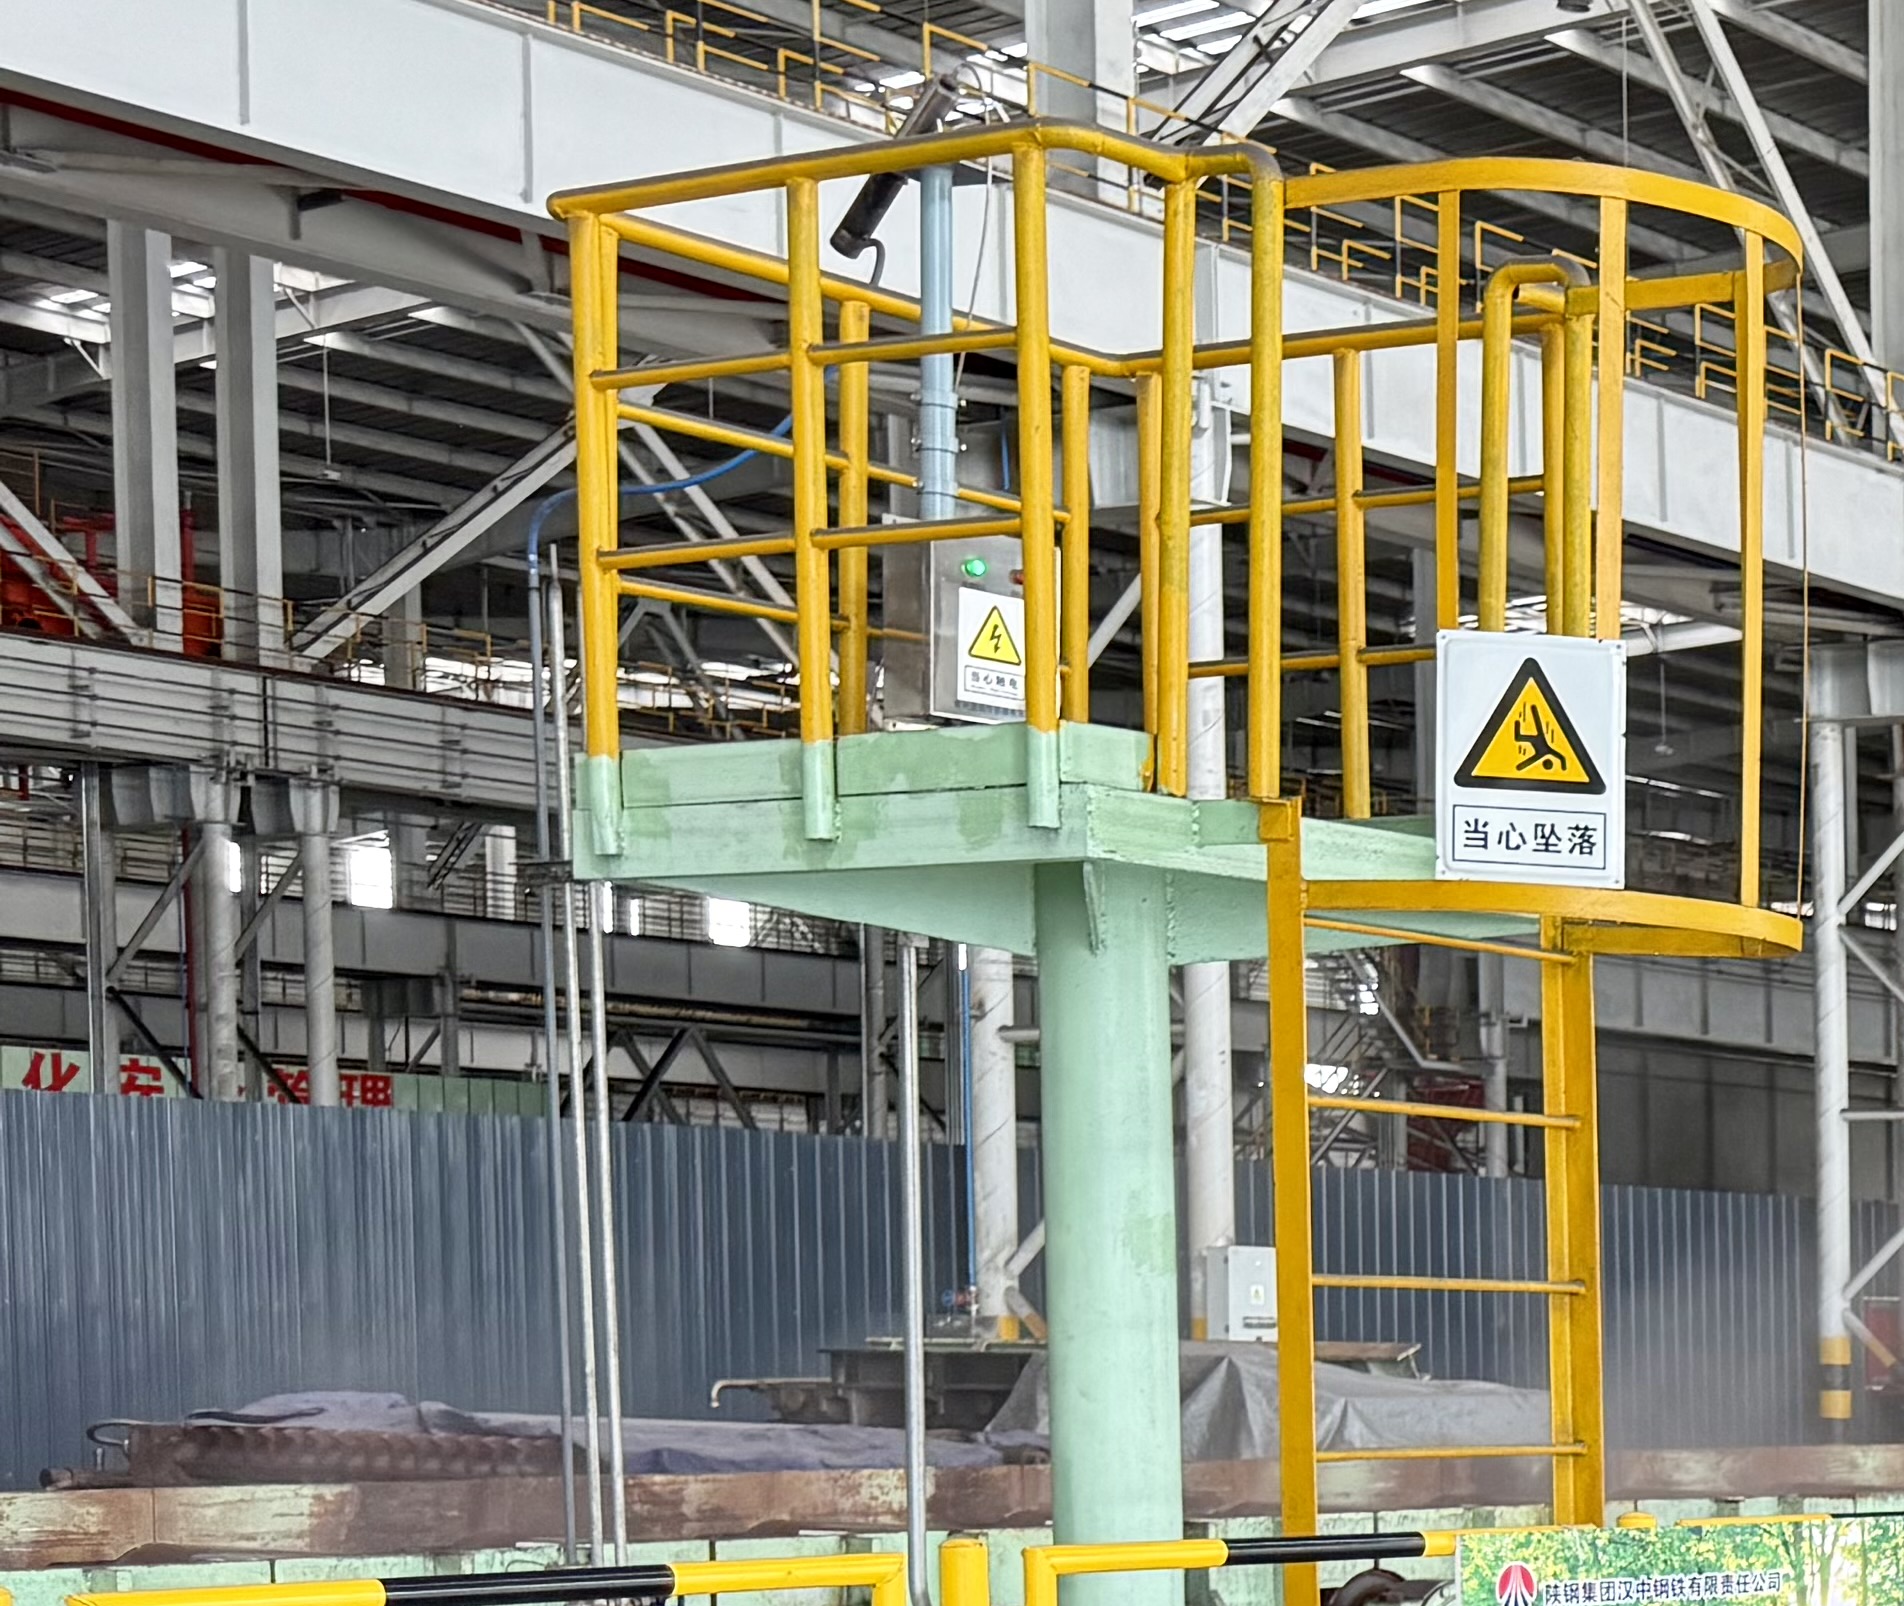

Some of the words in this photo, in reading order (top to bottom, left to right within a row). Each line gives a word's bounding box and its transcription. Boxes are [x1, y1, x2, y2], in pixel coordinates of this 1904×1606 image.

[1463, 818, 1597, 857] 当心坠落
[1545, 1572, 1782, 1604] 陕钢集团汉中钢铁有限责任公司
